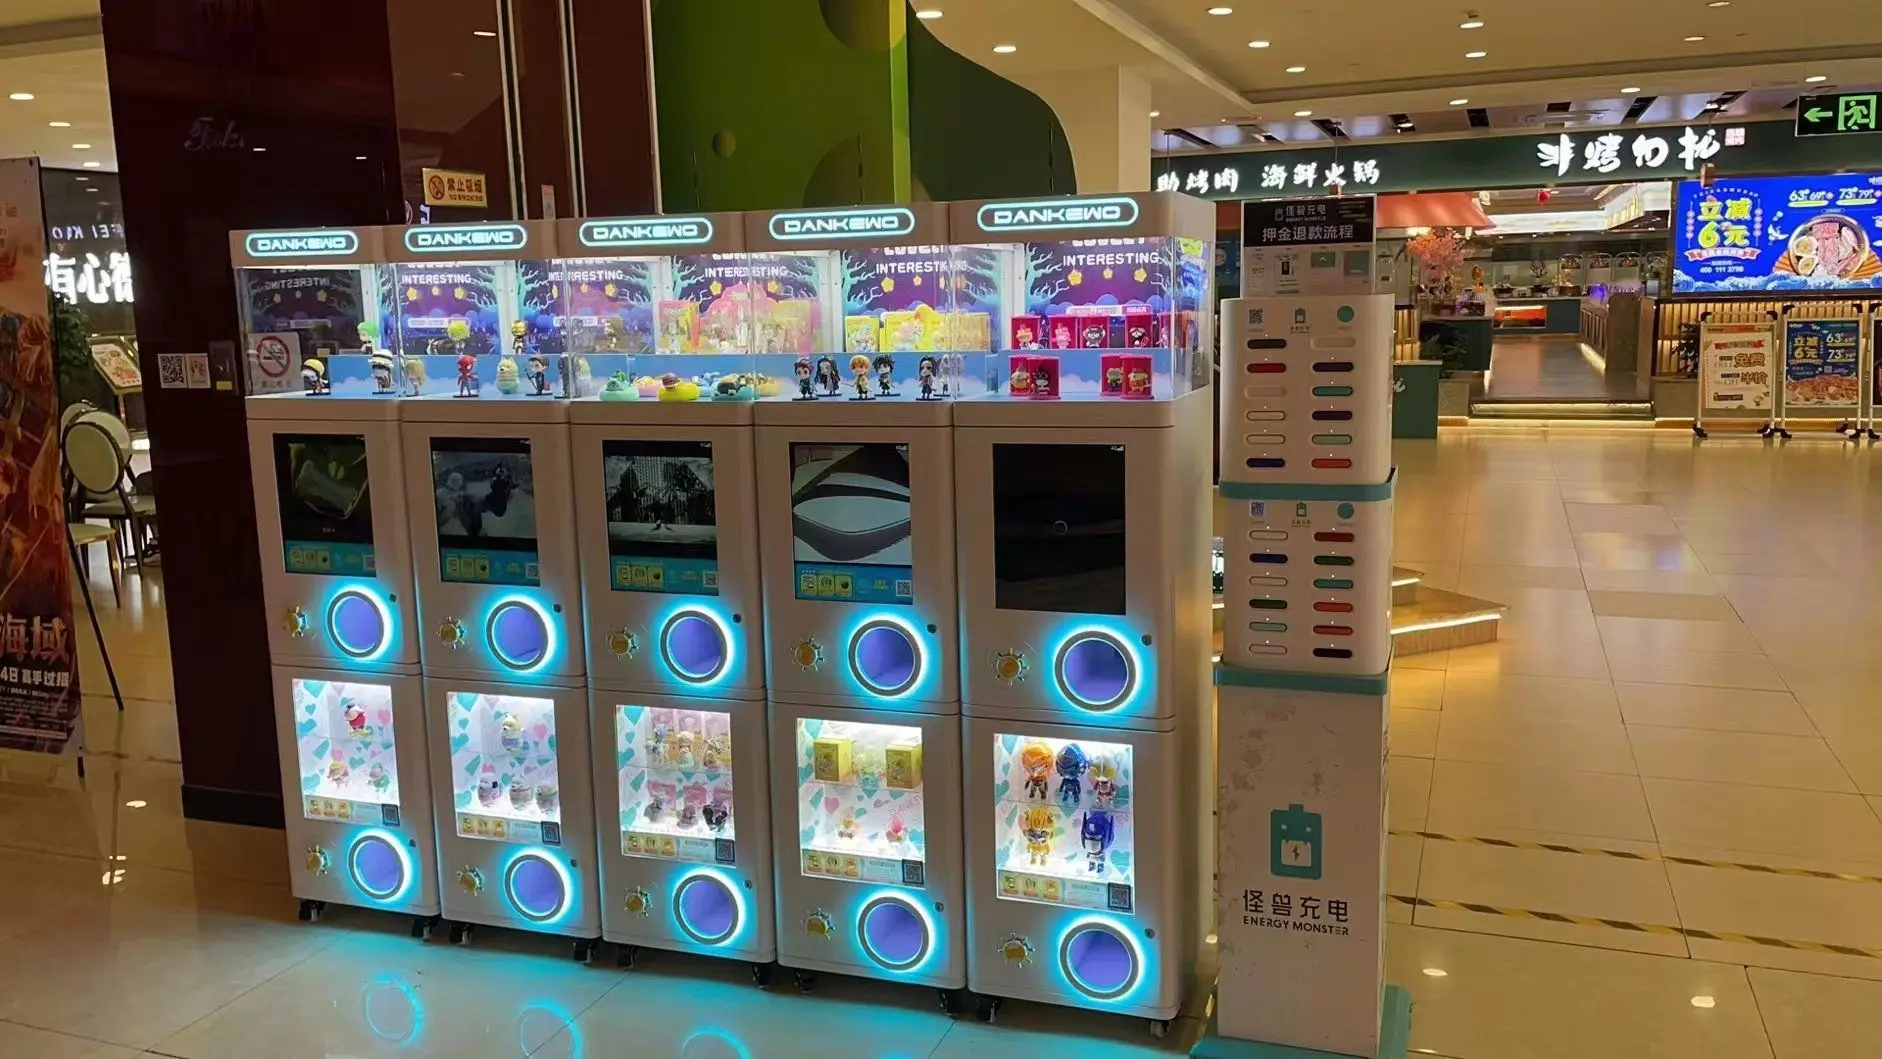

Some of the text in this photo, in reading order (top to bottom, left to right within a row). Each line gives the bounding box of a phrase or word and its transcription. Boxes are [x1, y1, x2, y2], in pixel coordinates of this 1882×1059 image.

[1261, 159, 1380, 190] 海鲜火锅
[994, 206, 1121, 224] DANKEWO
[1697, 198, 1753, 221] 立减
[593, 224, 699, 240] DANKEWO
[784, 216, 899, 233] DANKEWO
[1262, 224, 1354, 242] 押金退款流程
[418, 231, 514, 246] DANKEWO
[1698, 221, 1750, 248] 6元
[257, 237, 346, 251] DANKEWO
[1063, 252, 1159, 267] INTERESTING
[402, 273, 471, 284] INTERESTING
[1243, 889, 1349, 922] 怪兽充电
[1243, 915, 1349, 936] ENERGY MONSTER
